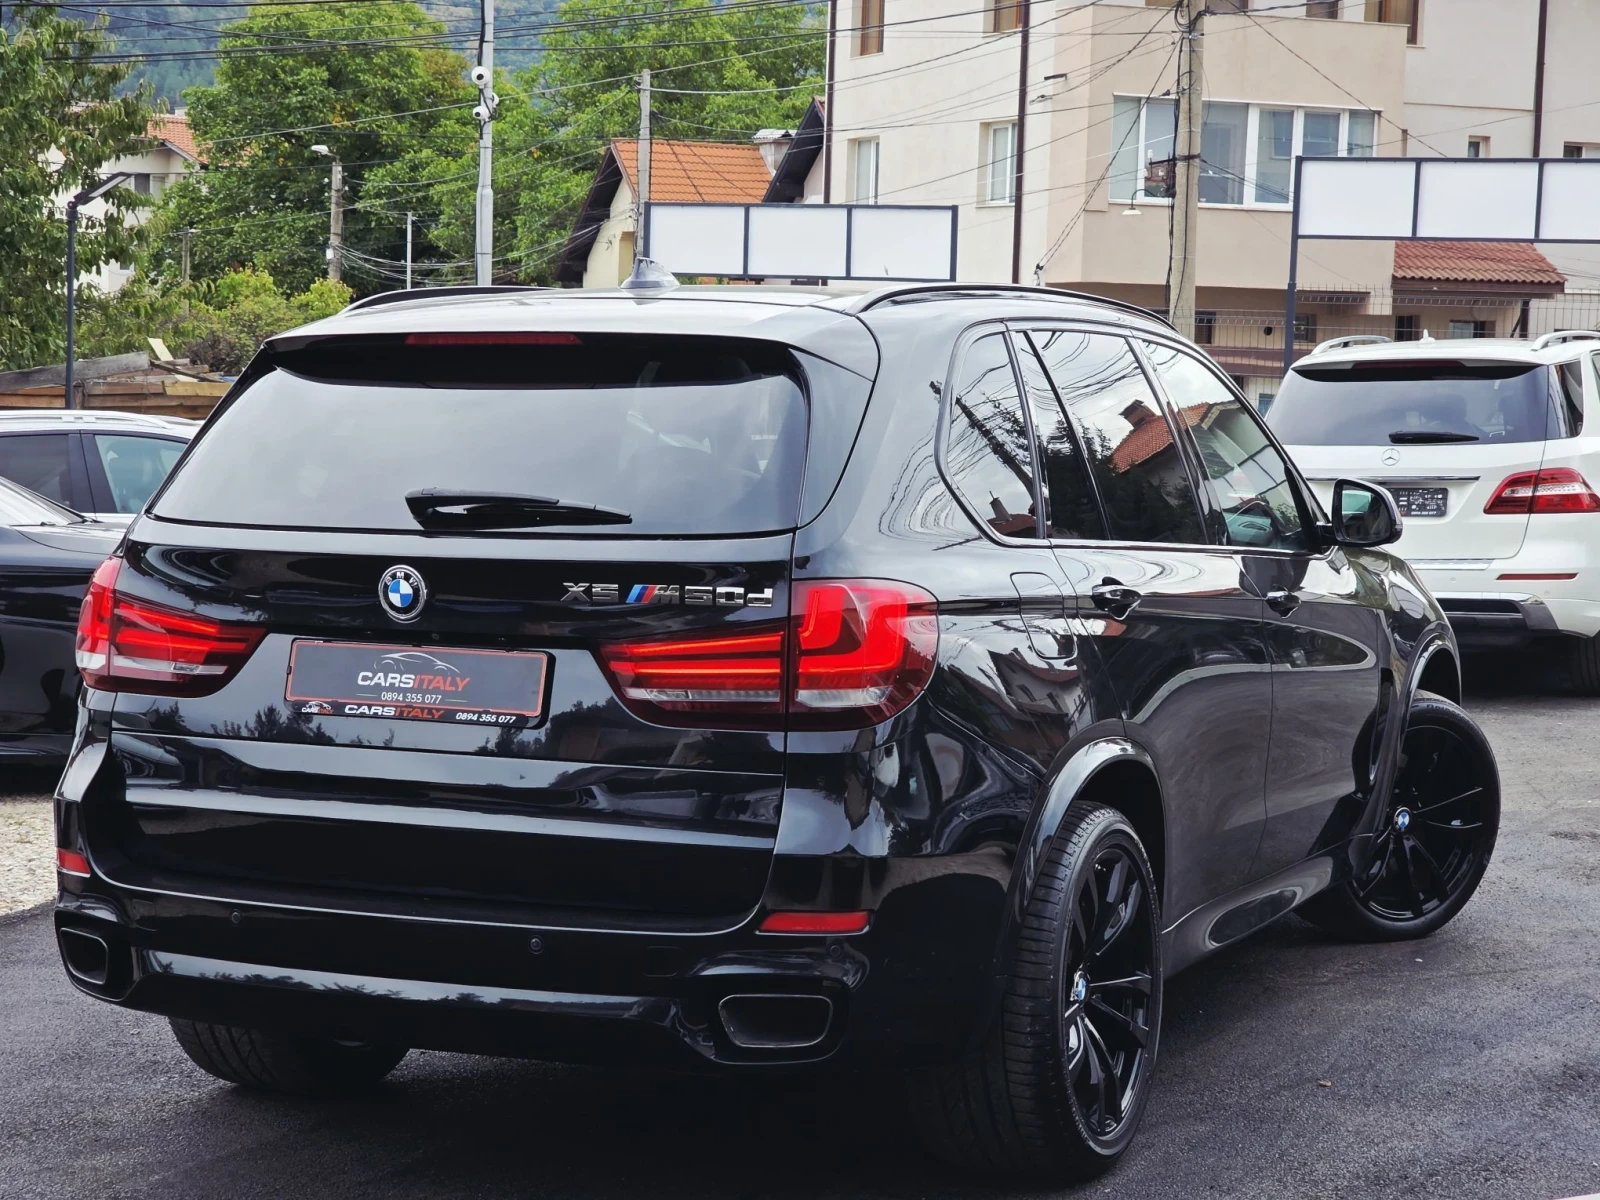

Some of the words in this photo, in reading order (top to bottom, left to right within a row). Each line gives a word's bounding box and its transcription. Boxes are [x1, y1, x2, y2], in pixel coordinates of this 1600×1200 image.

[385, 571, 418, 588] BMW
[560, 582, 619, 603] X5
[357, 671, 471, 692] CARSITALY
[381, 692, 403, 702] 0894
[405, 693, 422, 703] 355
[424, 694, 442, 704] 077
[344, 704, 445, 719] CARSITALY
[455, 712, 479, 721] 0894
[479, 713, 497, 722] 355
[497, 715, 517, 724] 077
